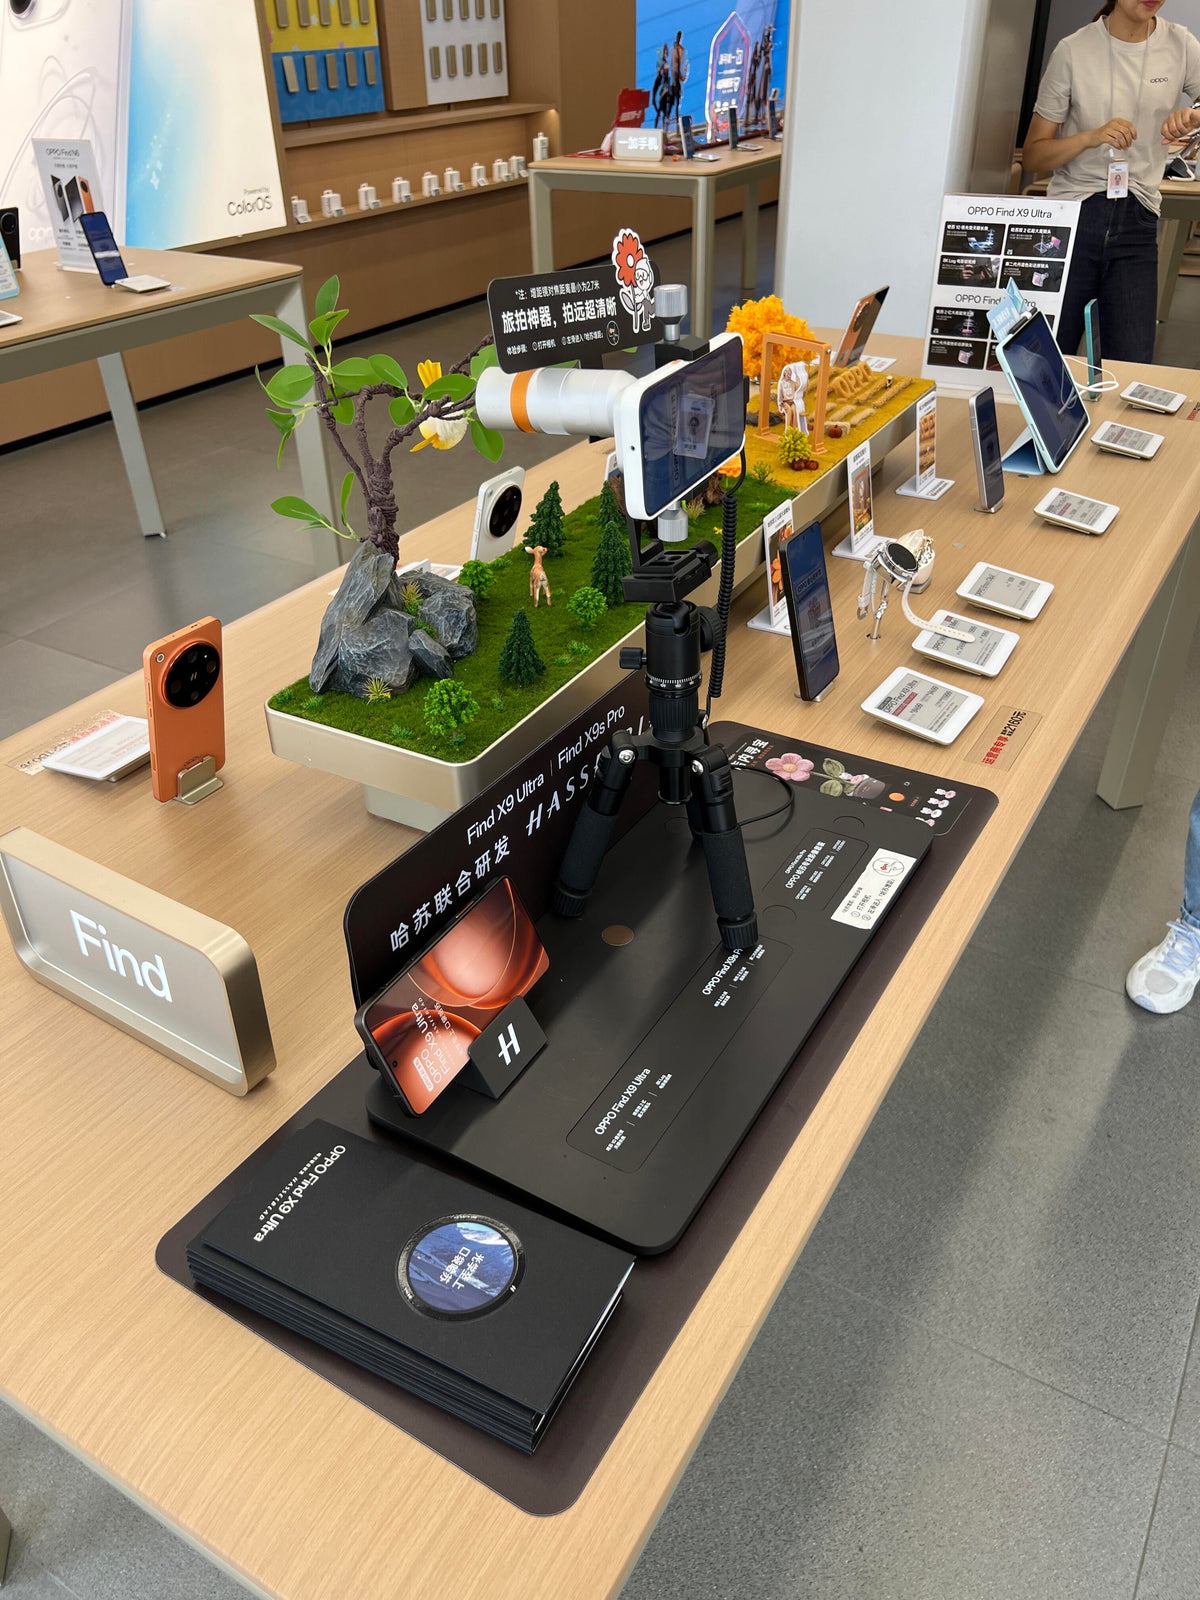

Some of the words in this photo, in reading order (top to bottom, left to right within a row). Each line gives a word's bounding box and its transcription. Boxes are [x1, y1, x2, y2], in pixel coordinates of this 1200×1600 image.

[227, 196, 272, 216] ColorOS
[967, 206, 994, 216] OPPO
[995, 207, 1015, 217] Find
[1016, 208, 1030, 218] X9
[1030, 209, 1053, 219] Ultra
[502, 296, 617, 334] 旅拍神器，拍远超清晰
[955, 294, 981, 303] OPPO
[982, 295, 1002, 305] Find
[883, 698, 898, 713] OPPO
[894, 691, 906, 703] Find
[467, 810, 495, 845] Find
[497, 794, 515, 822] X9
[516, 772, 544, 803] Ultra
[557, 740, 583, 769] Find
[584, 722, 606, 748] X9s
[607, 705, 625, 728] Pro
[390, 835, 511, 952] 哈苏联合研发
[785, 873, 801, 889] OPPO
[69, 909, 173, 1003] Find
[701, 976, 721, 996] OPPO
[715, 963, 731, 979] Find
[724, 952, 739, 966] X9s
[411, 1002, 428, 1034] Ultra
[425, 1032, 438, 1050] X9
[498, 1022, 521, 1066] H
[420, 1049, 442, 1084] OPPO
[435, 1048, 452, 1075] Find
[594, 1110, 617, 1135] OPPO
[611, 1094, 630, 1113] Find
[623, 1083, 638, 1098] X9
[631, 1068, 651, 1087] Ultra
[314, 1145, 346, 1175] OPPO
[259, 1176, 299, 1221] HASSELBLAD
[292, 1172, 320, 1198] Find
[278, 1195, 300, 1215] X9
[253, 1213, 285, 1243] Ultra
[439, 1247, 471, 1284] 口袋哈苏
[452, 1252, 485, 1290] 光学至上
